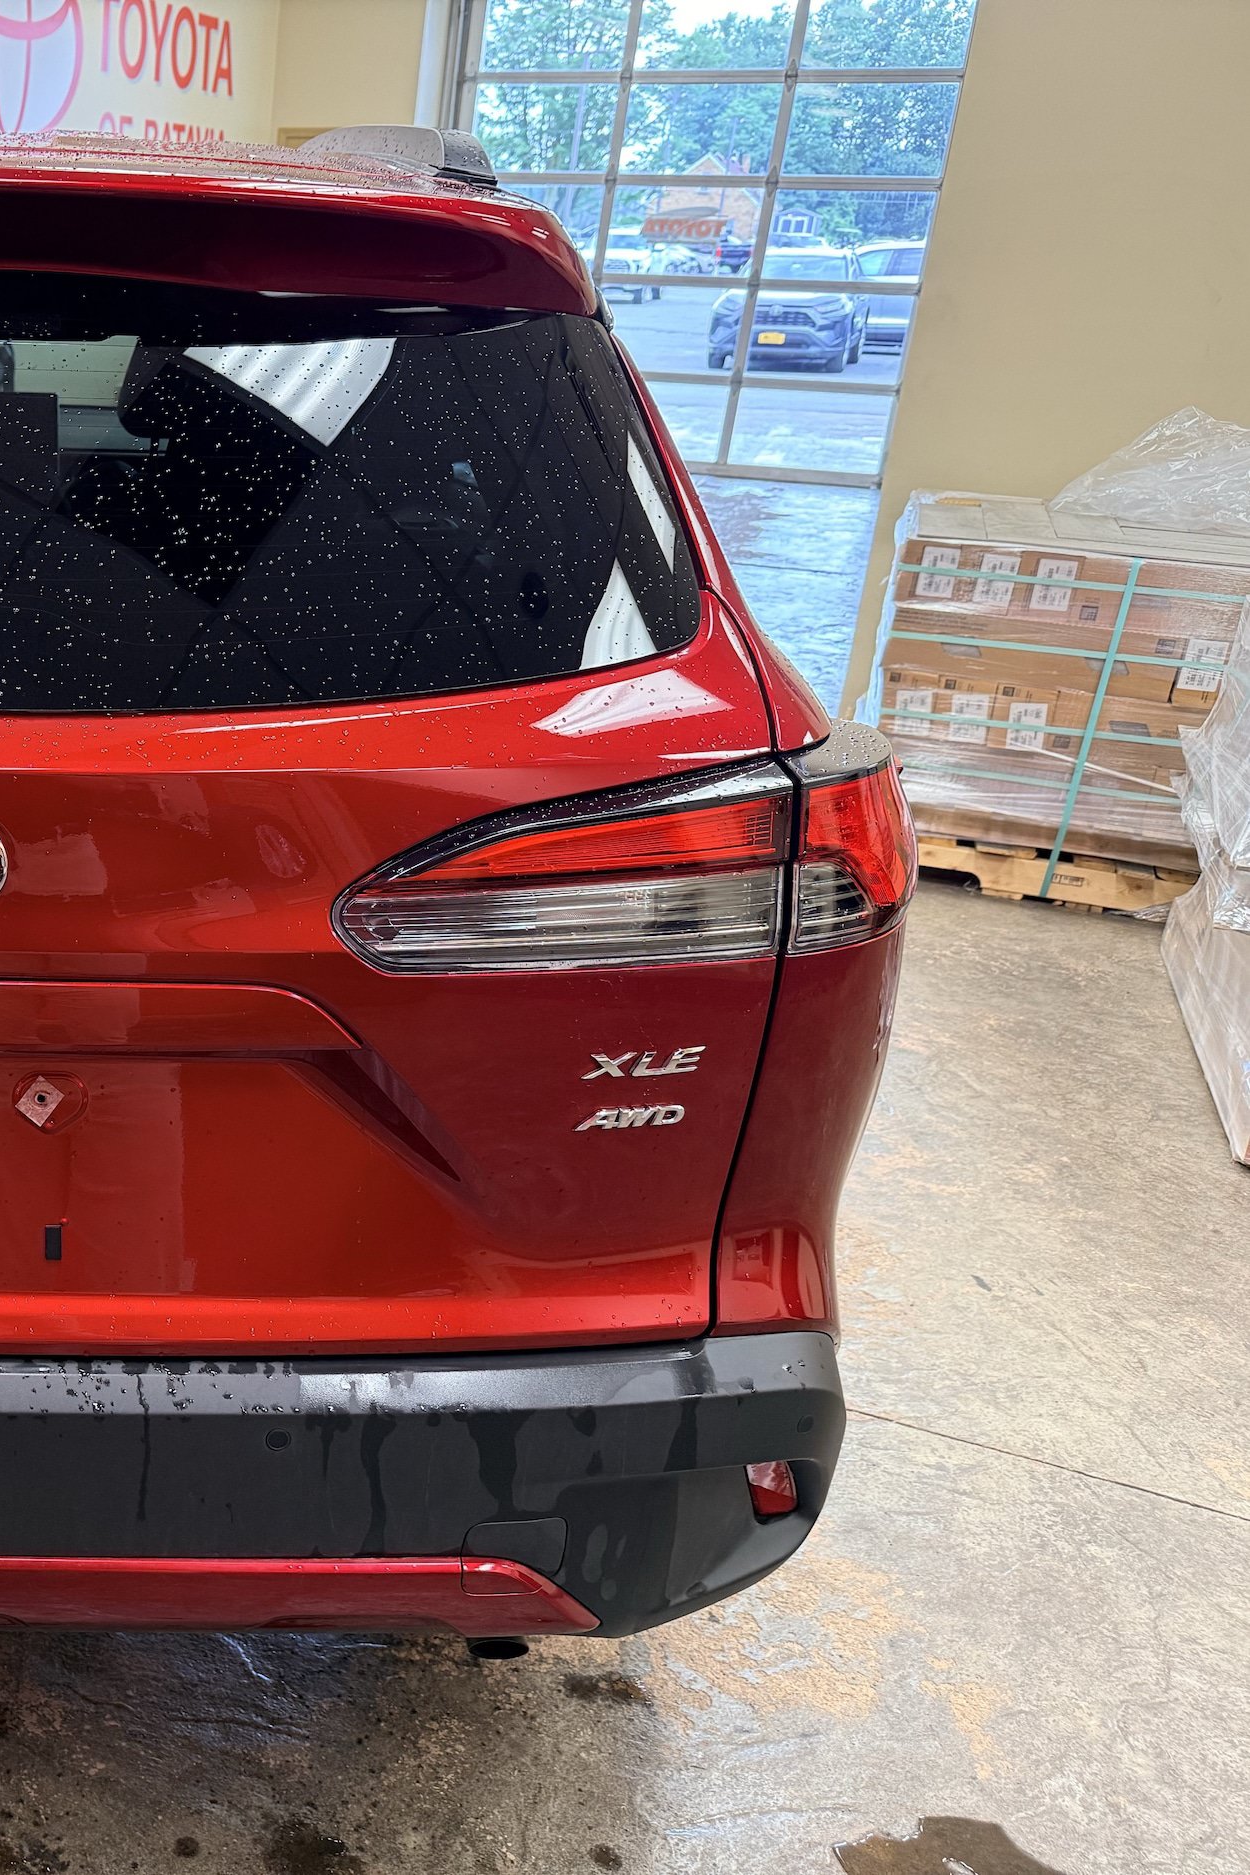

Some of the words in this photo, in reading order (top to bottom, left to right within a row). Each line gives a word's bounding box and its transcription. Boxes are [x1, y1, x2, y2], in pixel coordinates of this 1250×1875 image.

[101, 0, 233, 97] TOYOTA
[581, 1045, 707, 1080] XLE
[572, 1104, 685, 1131] AWD
